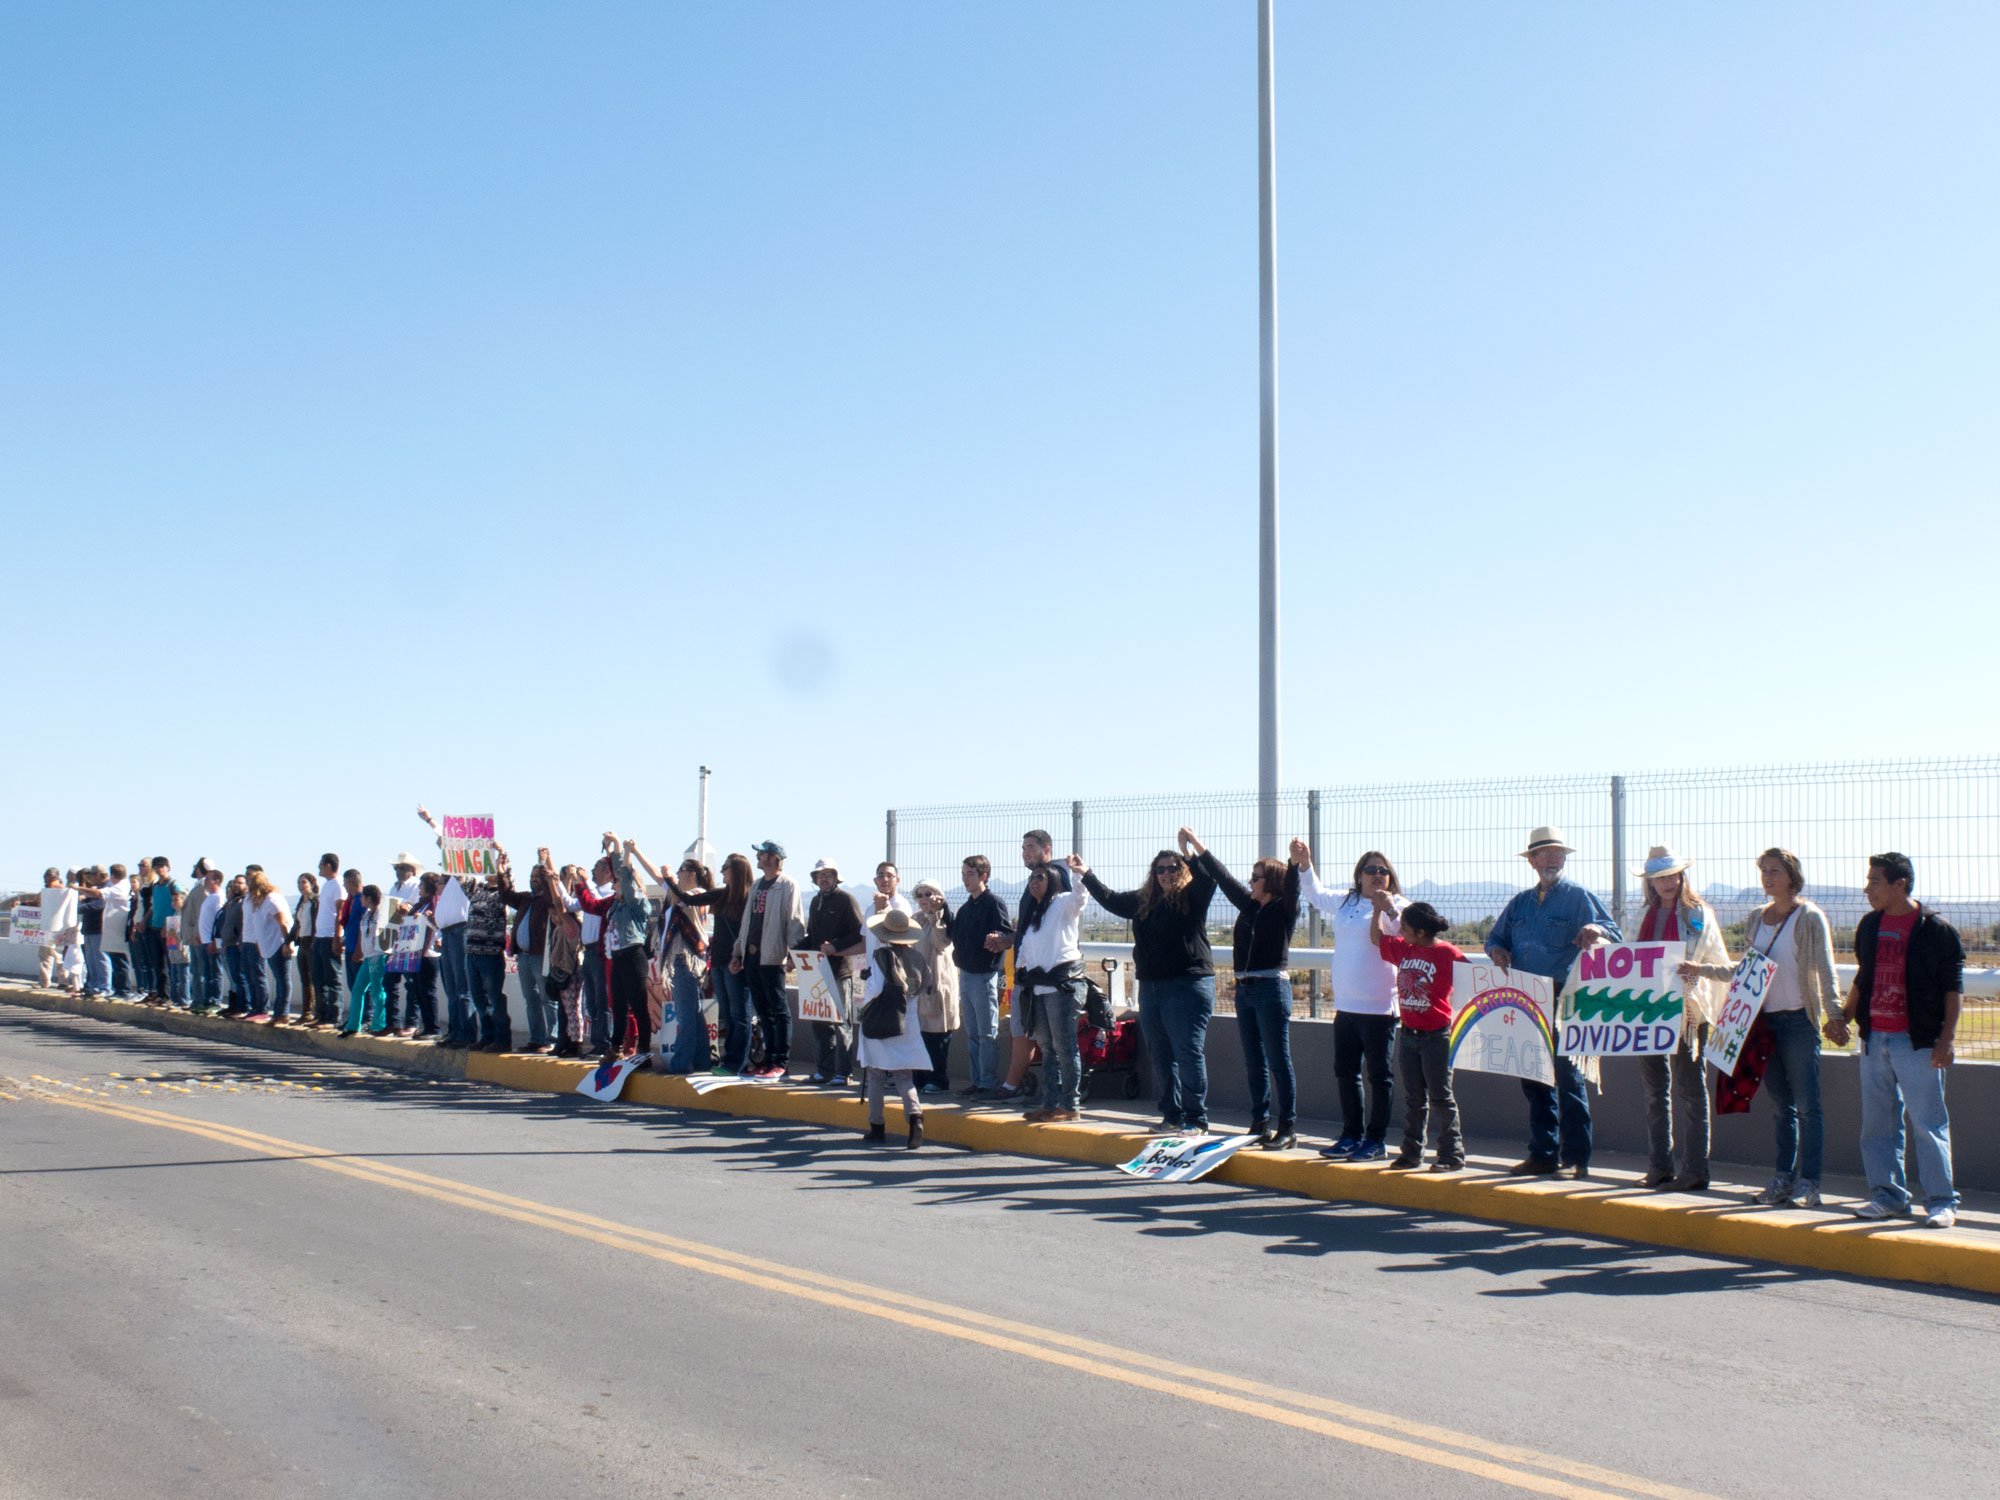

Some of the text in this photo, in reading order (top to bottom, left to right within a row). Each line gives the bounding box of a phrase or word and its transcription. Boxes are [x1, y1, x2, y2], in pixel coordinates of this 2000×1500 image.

[1580, 947, 1665, 981] NOT
[1472, 966, 1547, 1004] BUILD
[1474, 988, 1539, 1023] BRIDGES
[1503, 1009, 1516, 1026] of
[1471, 1032, 1548, 1079] PEACE
[1565, 1025, 1676, 1052] DIVIDED
